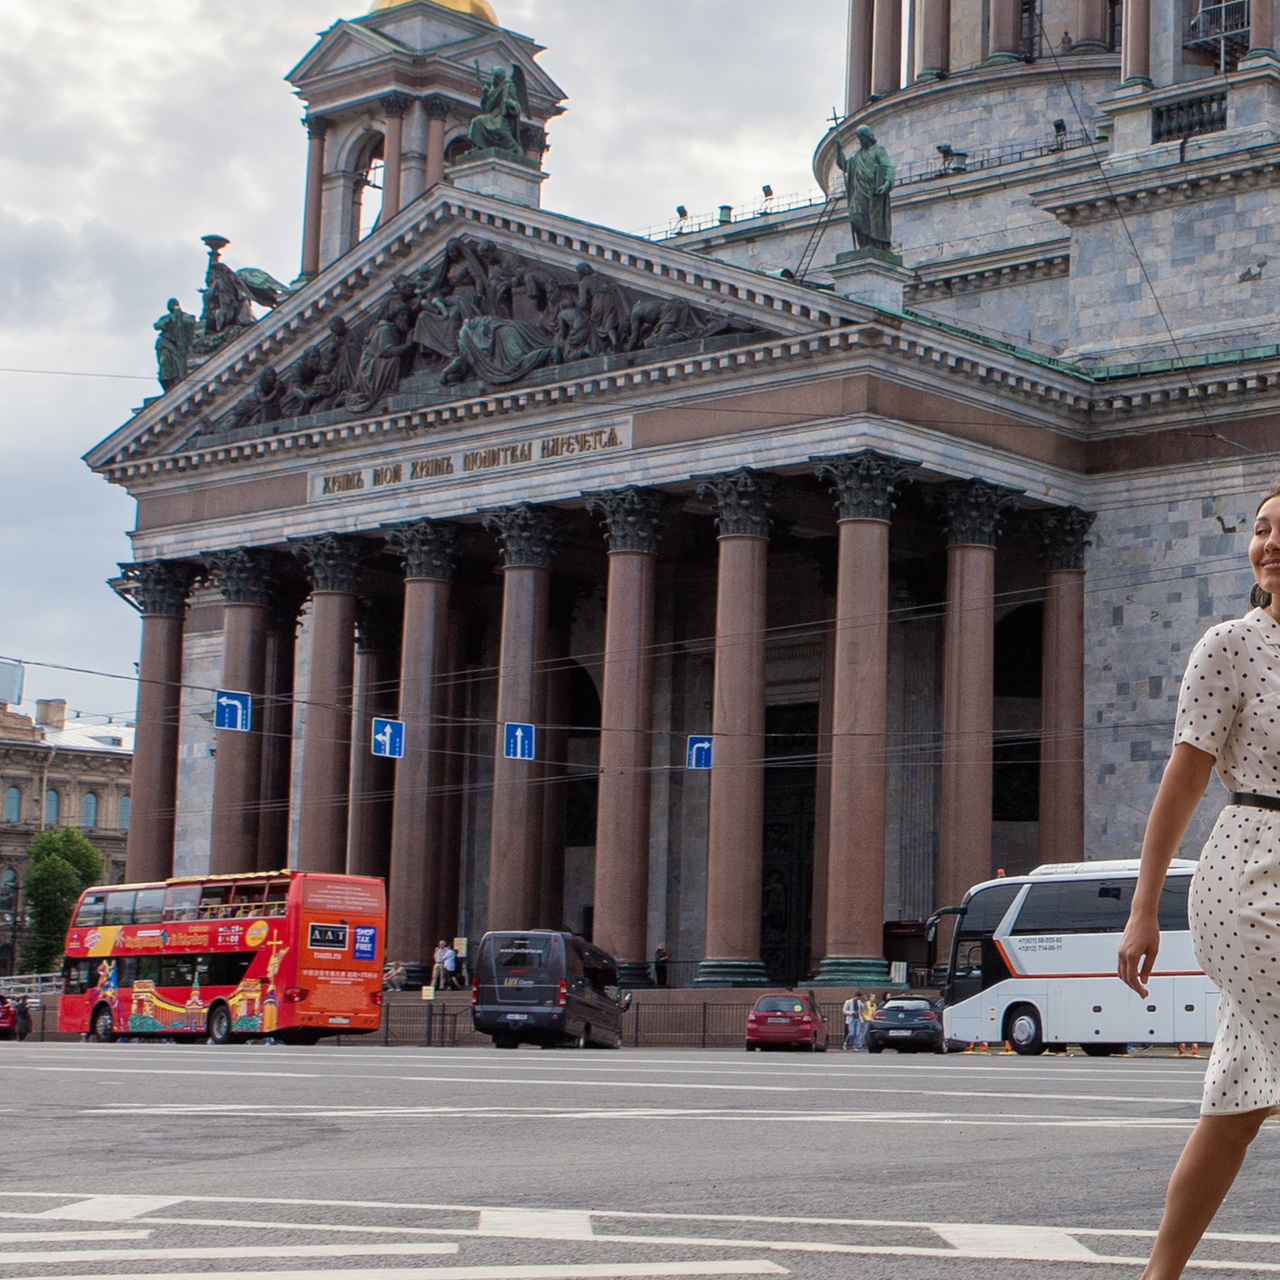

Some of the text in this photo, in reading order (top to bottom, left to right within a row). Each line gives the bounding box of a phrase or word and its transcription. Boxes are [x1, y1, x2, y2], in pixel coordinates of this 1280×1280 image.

[357, 928, 375, 936] SHOP
[356, 943, 373, 951] FREE
[504, 978, 518, 986] LUX
